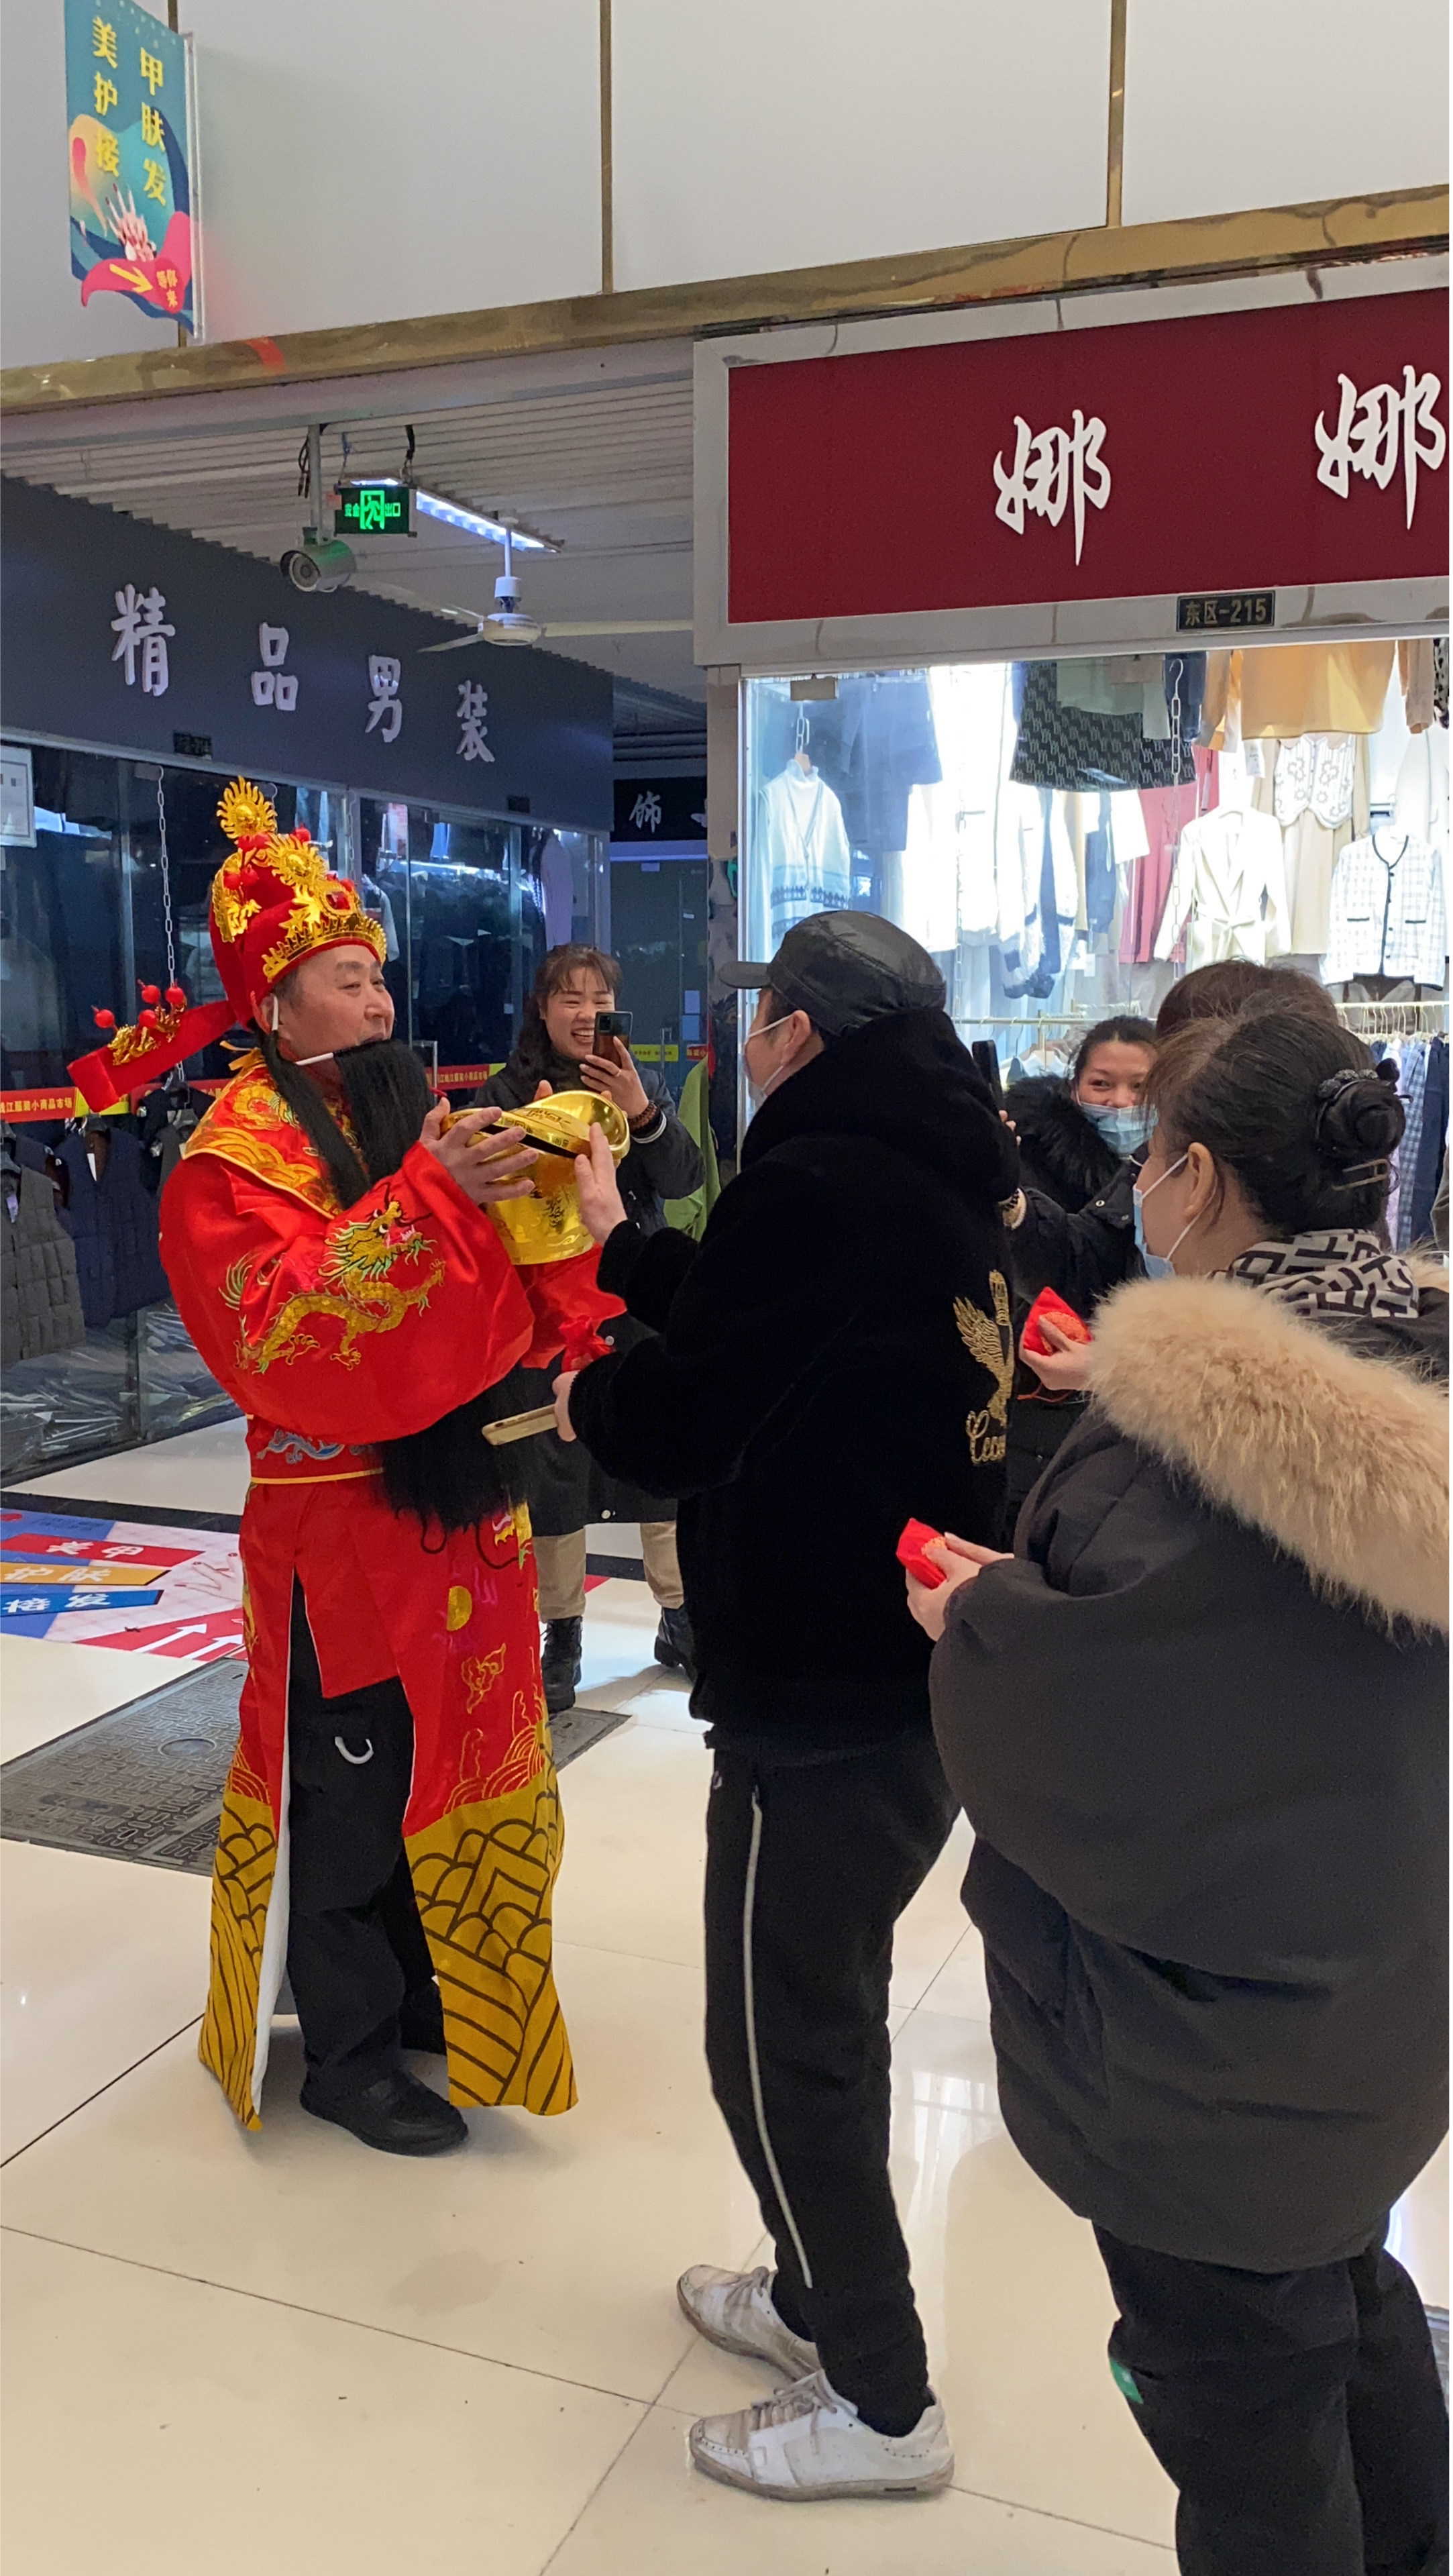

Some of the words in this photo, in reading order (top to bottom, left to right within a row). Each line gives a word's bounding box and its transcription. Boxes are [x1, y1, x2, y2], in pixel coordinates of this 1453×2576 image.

[993, 364, 1447, 566] 娜娜
[1185, 597, 1267, 627] 东区-215
[111, 584, 495, 763] 精品男装
[46, 1541, 145, 1559] 美甲
[4, 1566, 113, 1582] 护肤
